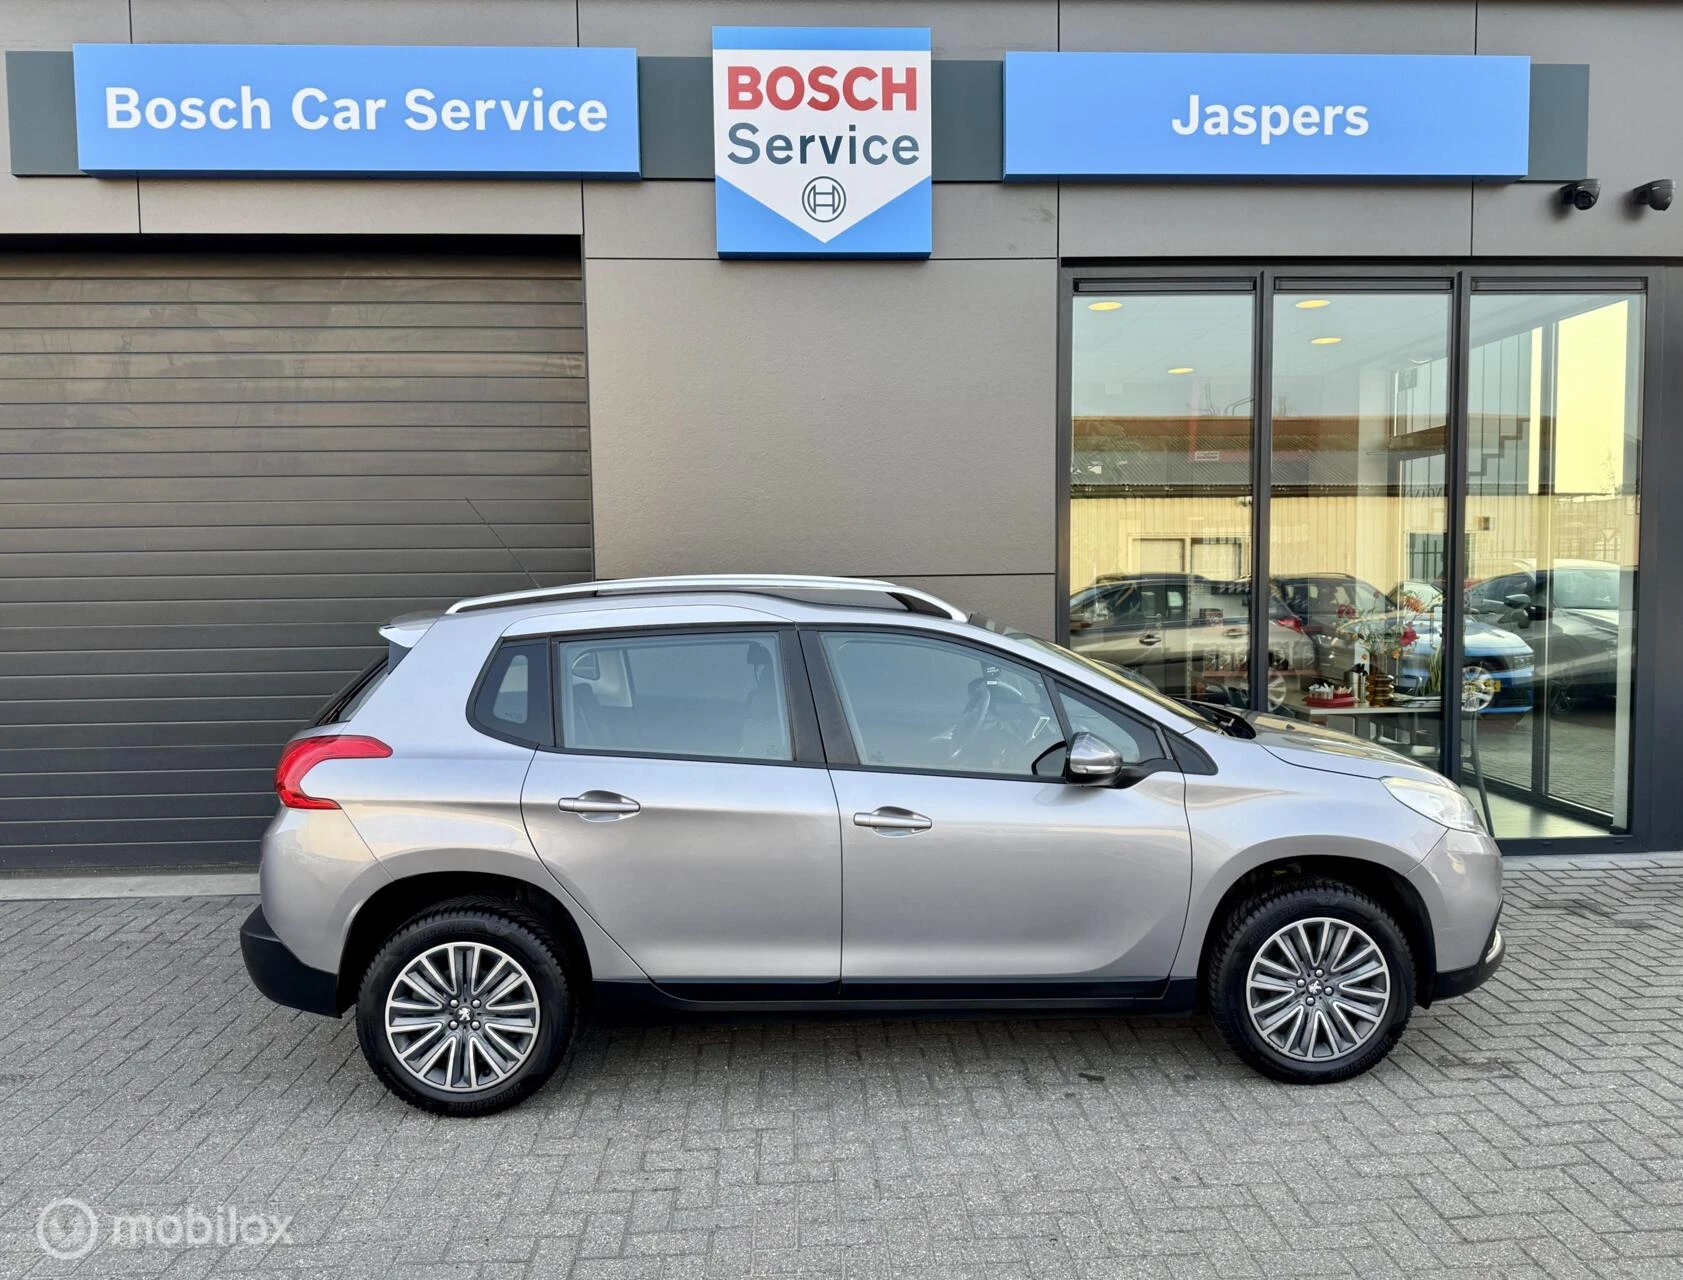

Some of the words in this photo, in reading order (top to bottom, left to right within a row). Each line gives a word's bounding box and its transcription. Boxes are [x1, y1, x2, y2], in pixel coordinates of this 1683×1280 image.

[105, 86, 271, 131] Bosch
[291, 87, 387, 131] Car
[405, 87, 608, 133] Service
[727, 66, 917, 112] BOSCH
[1171, 94, 1370, 145] Jaspers
[727, 122, 920, 166] Service
